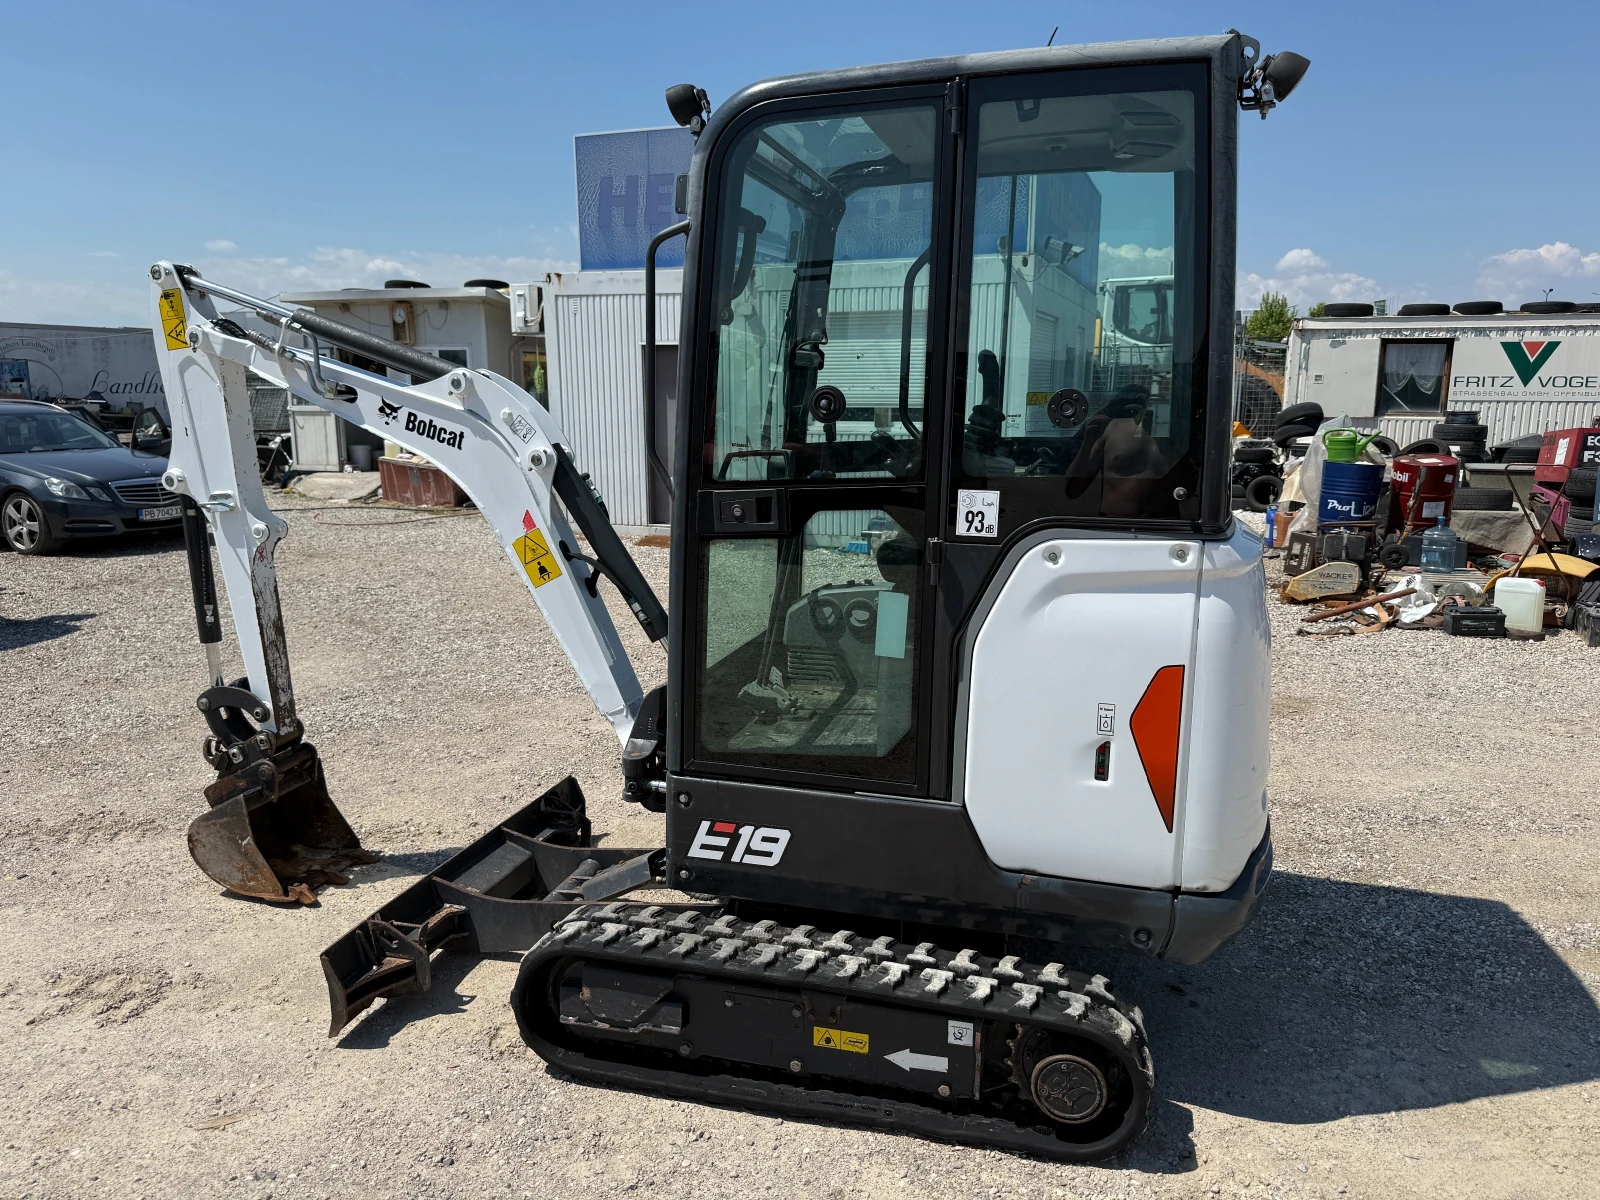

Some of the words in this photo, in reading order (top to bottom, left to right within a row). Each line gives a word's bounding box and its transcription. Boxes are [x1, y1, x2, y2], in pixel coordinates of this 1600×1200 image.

[1453, 376, 1515, 388] FRITZ
[1538, 376, 1600, 388] VOGE
[405, 411, 465, 450] Bobcat
[144, 510, 155, 518] PB
[156, 508, 174, 517] 7042
[965, 510, 985, 533] 93
[985, 524, 994, 533] dB
[1319, 571, 1353, 580] WACKER
[687, 820, 792, 867] E19
